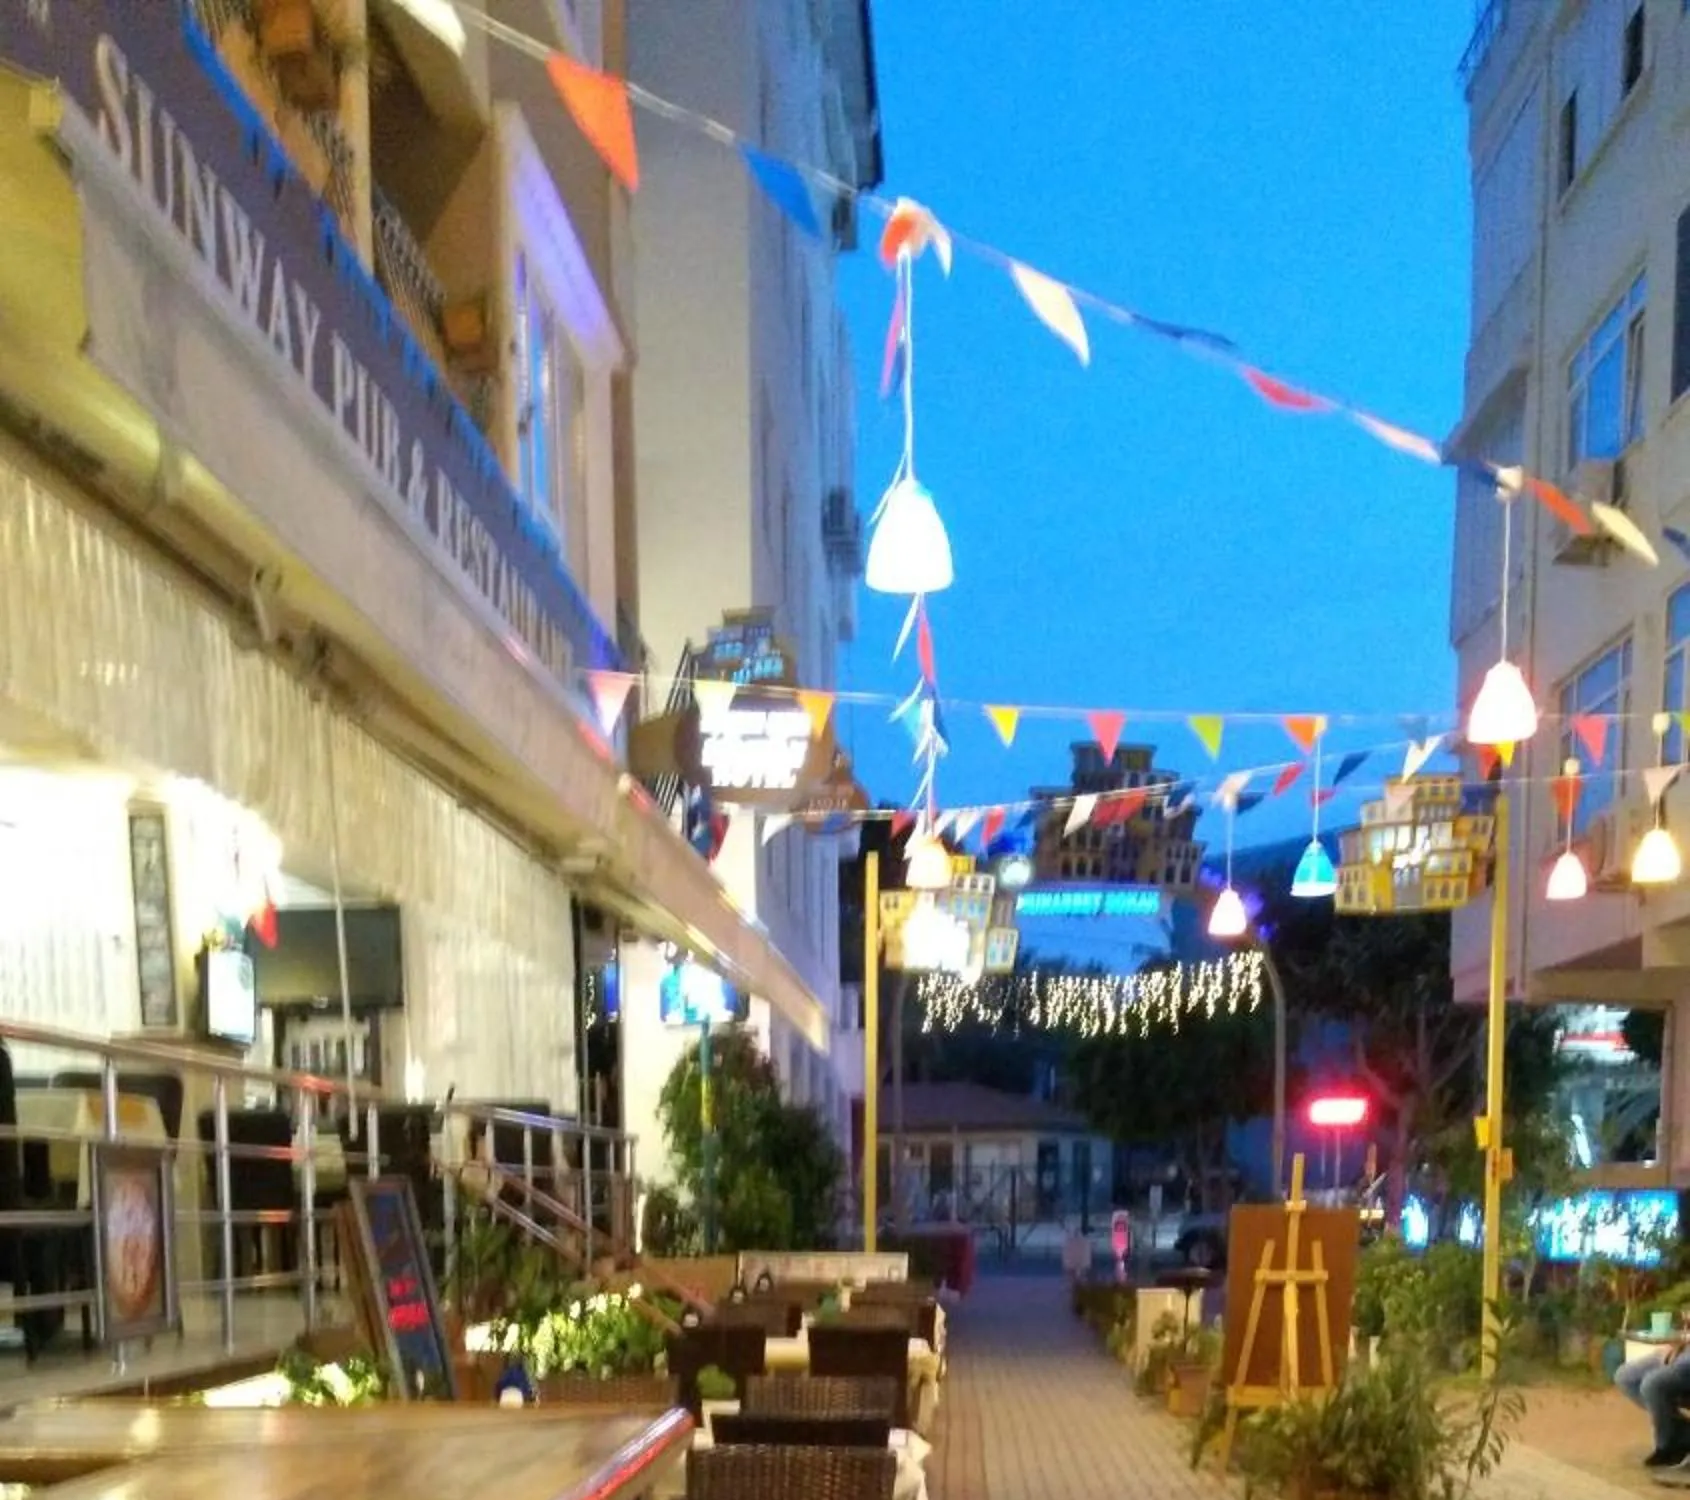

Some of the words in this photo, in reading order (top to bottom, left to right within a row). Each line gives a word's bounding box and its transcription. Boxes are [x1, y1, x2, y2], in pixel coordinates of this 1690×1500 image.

[96, 32, 320, 392] SUNWAY
[329, 329, 400, 494] PUB
[407, 437, 429, 521] &
